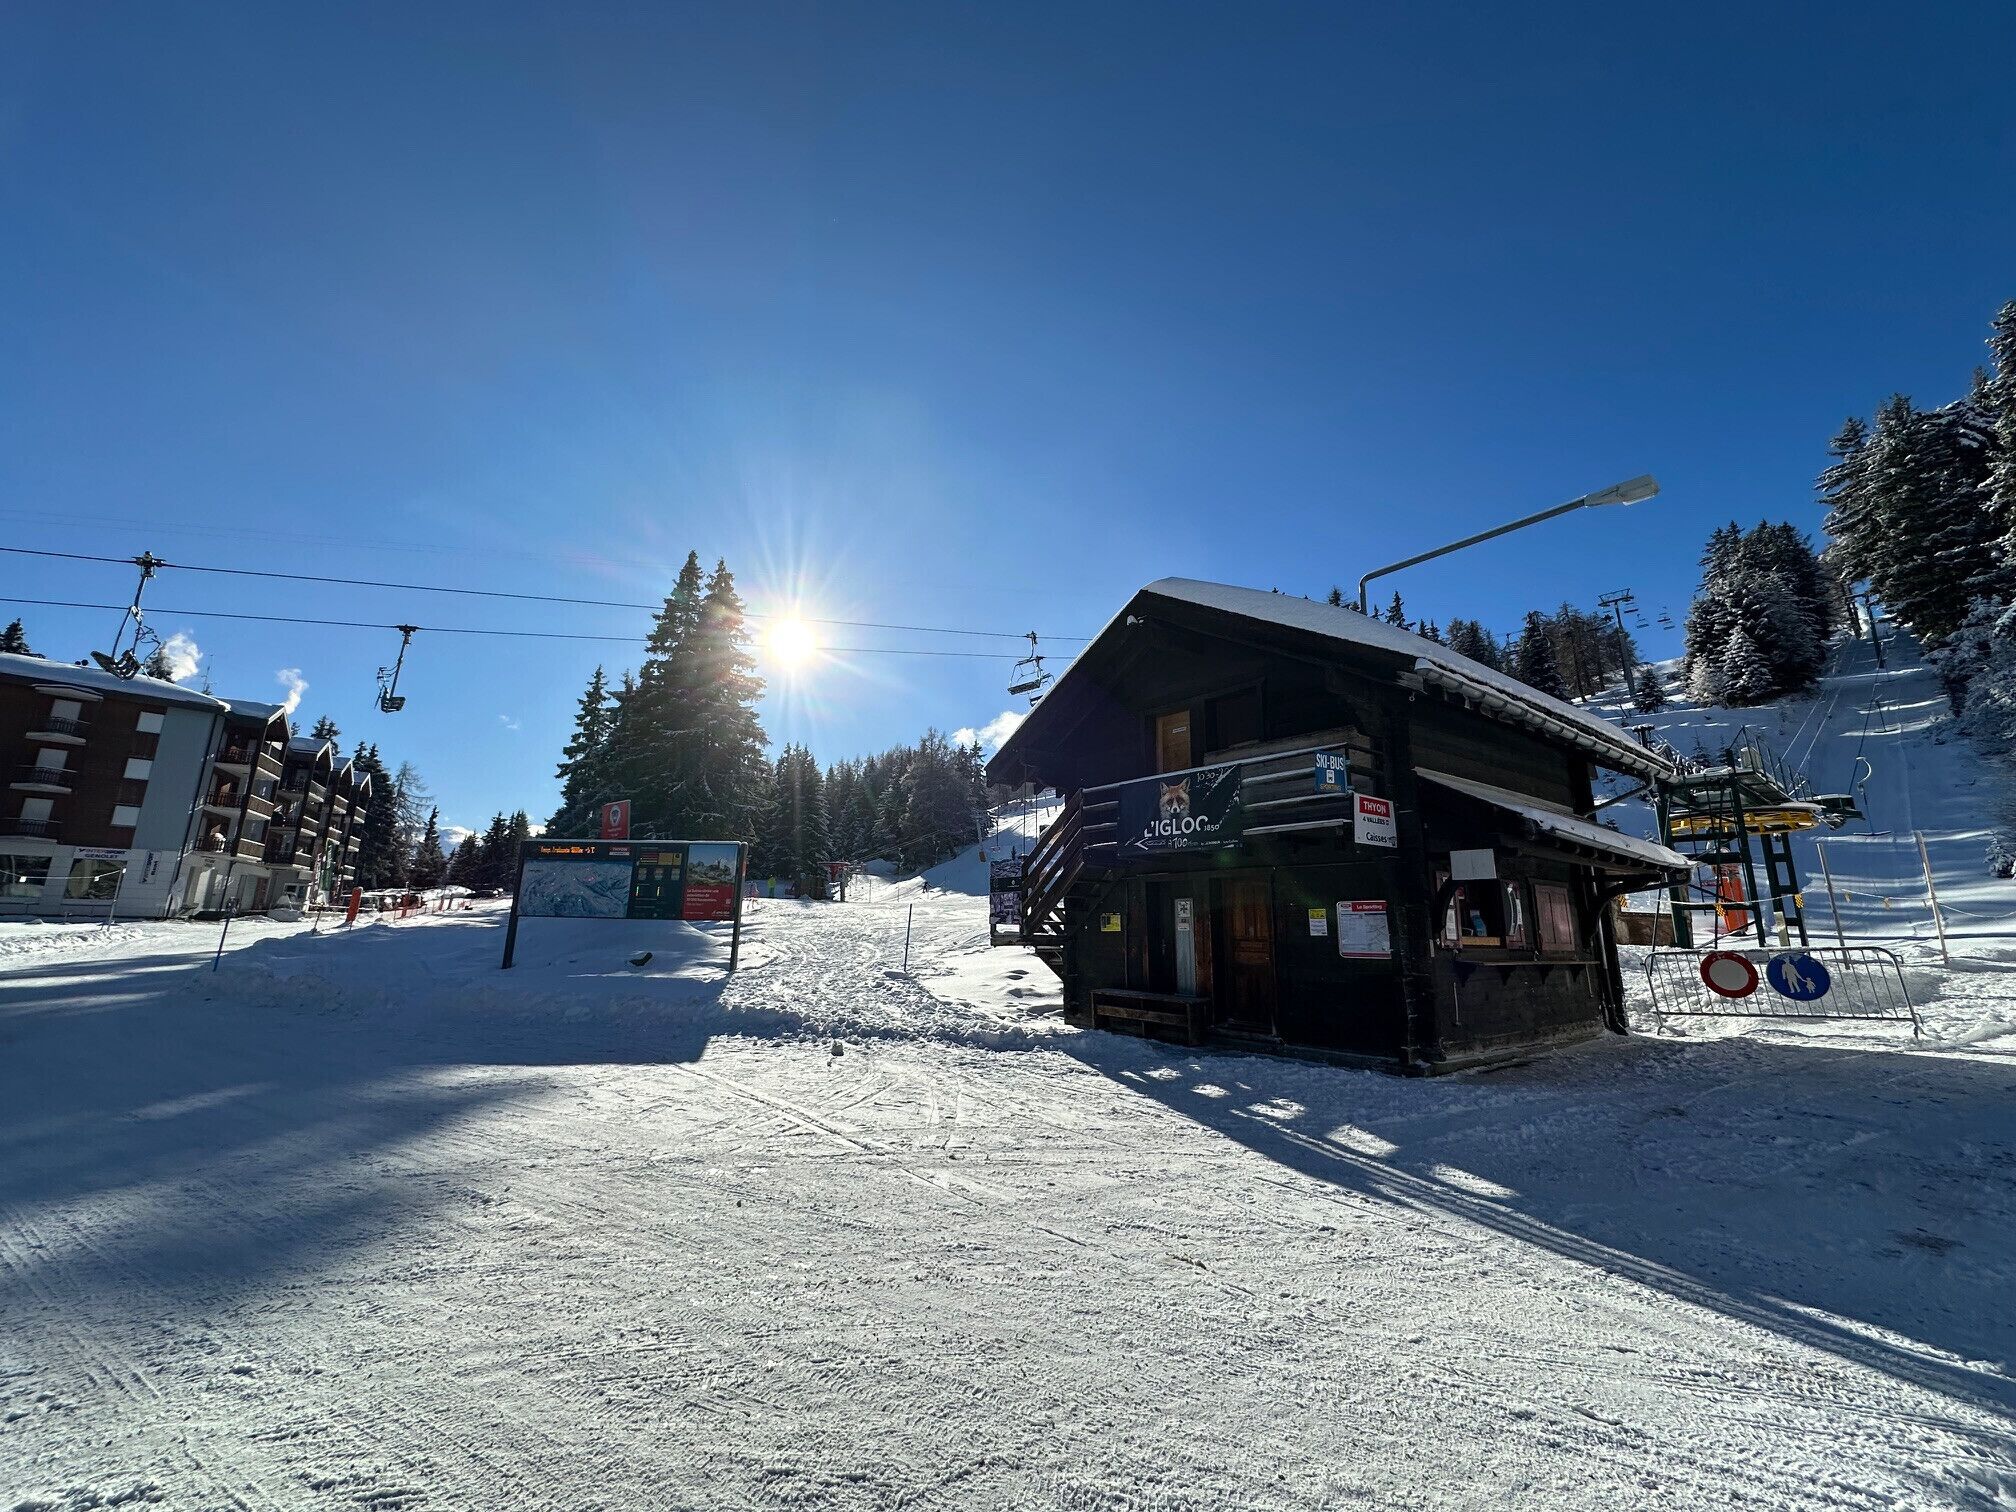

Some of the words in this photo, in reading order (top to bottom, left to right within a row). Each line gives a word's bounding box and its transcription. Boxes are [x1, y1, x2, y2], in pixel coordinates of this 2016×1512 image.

[1316, 753, 1344, 770] SKI-BUS
[1363, 801, 1386, 814] THYON
[1366, 832, 1387, 843] Caisses
